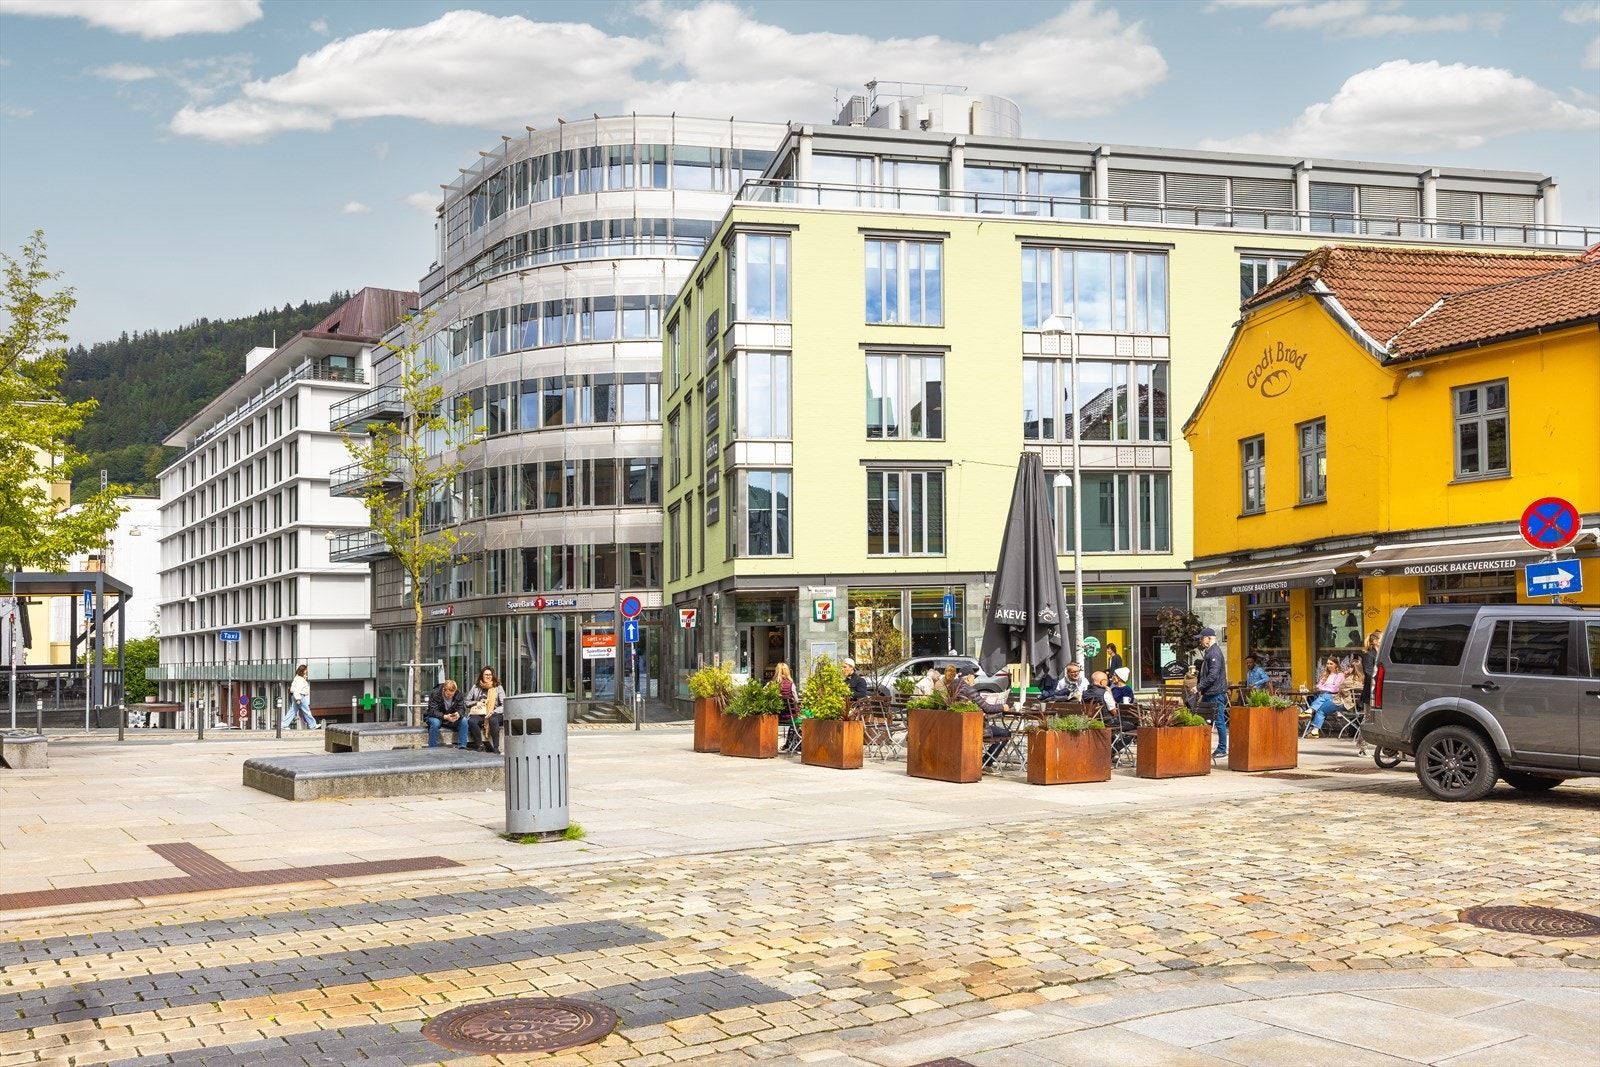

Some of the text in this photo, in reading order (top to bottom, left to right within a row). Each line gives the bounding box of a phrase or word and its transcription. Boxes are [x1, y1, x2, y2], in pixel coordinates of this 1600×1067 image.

[1247, 341, 1308, 389] Godt Brød
[1404, 560, 1516, 575] ØKOLOGISK BAKEVERKSTED
[1231, 581, 1288, 593] ØKOLOGISK BAKEVERKSTED
[507, 600, 536, 609] SpareBank
[817, 602, 831, 620] 7
